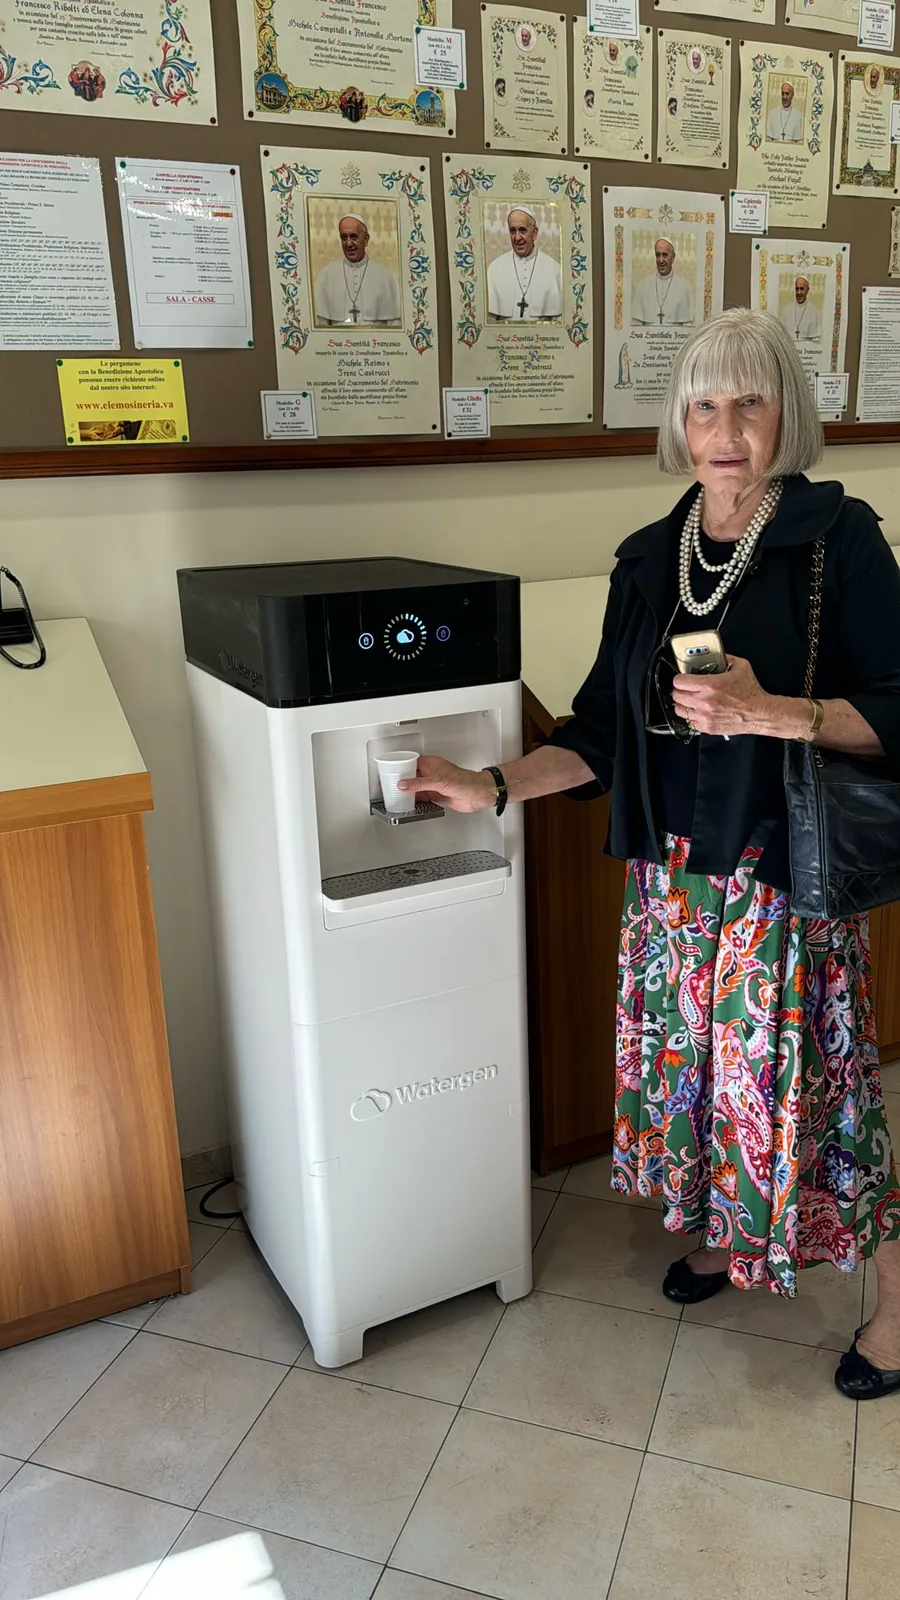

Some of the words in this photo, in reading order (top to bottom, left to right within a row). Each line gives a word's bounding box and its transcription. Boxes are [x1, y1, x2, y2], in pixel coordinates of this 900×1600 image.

[192, 296, 217, 304] CASSE
[328, 338, 342, 348] Sua
[344, 338, 370, 348] Santità
[372, 338, 401, 348] Francesco
[535, 334, 560, 343] Francesco
[109, 360, 142, 368] pergamene
[337, 359, 362, 368] Michele
[134, 368, 164, 376] Apostolica
[358, 368, 390, 377] Castrucci
[76, 400, 174, 410] www.elemosineria.va
[396, 1064, 498, 1105] Watergen
